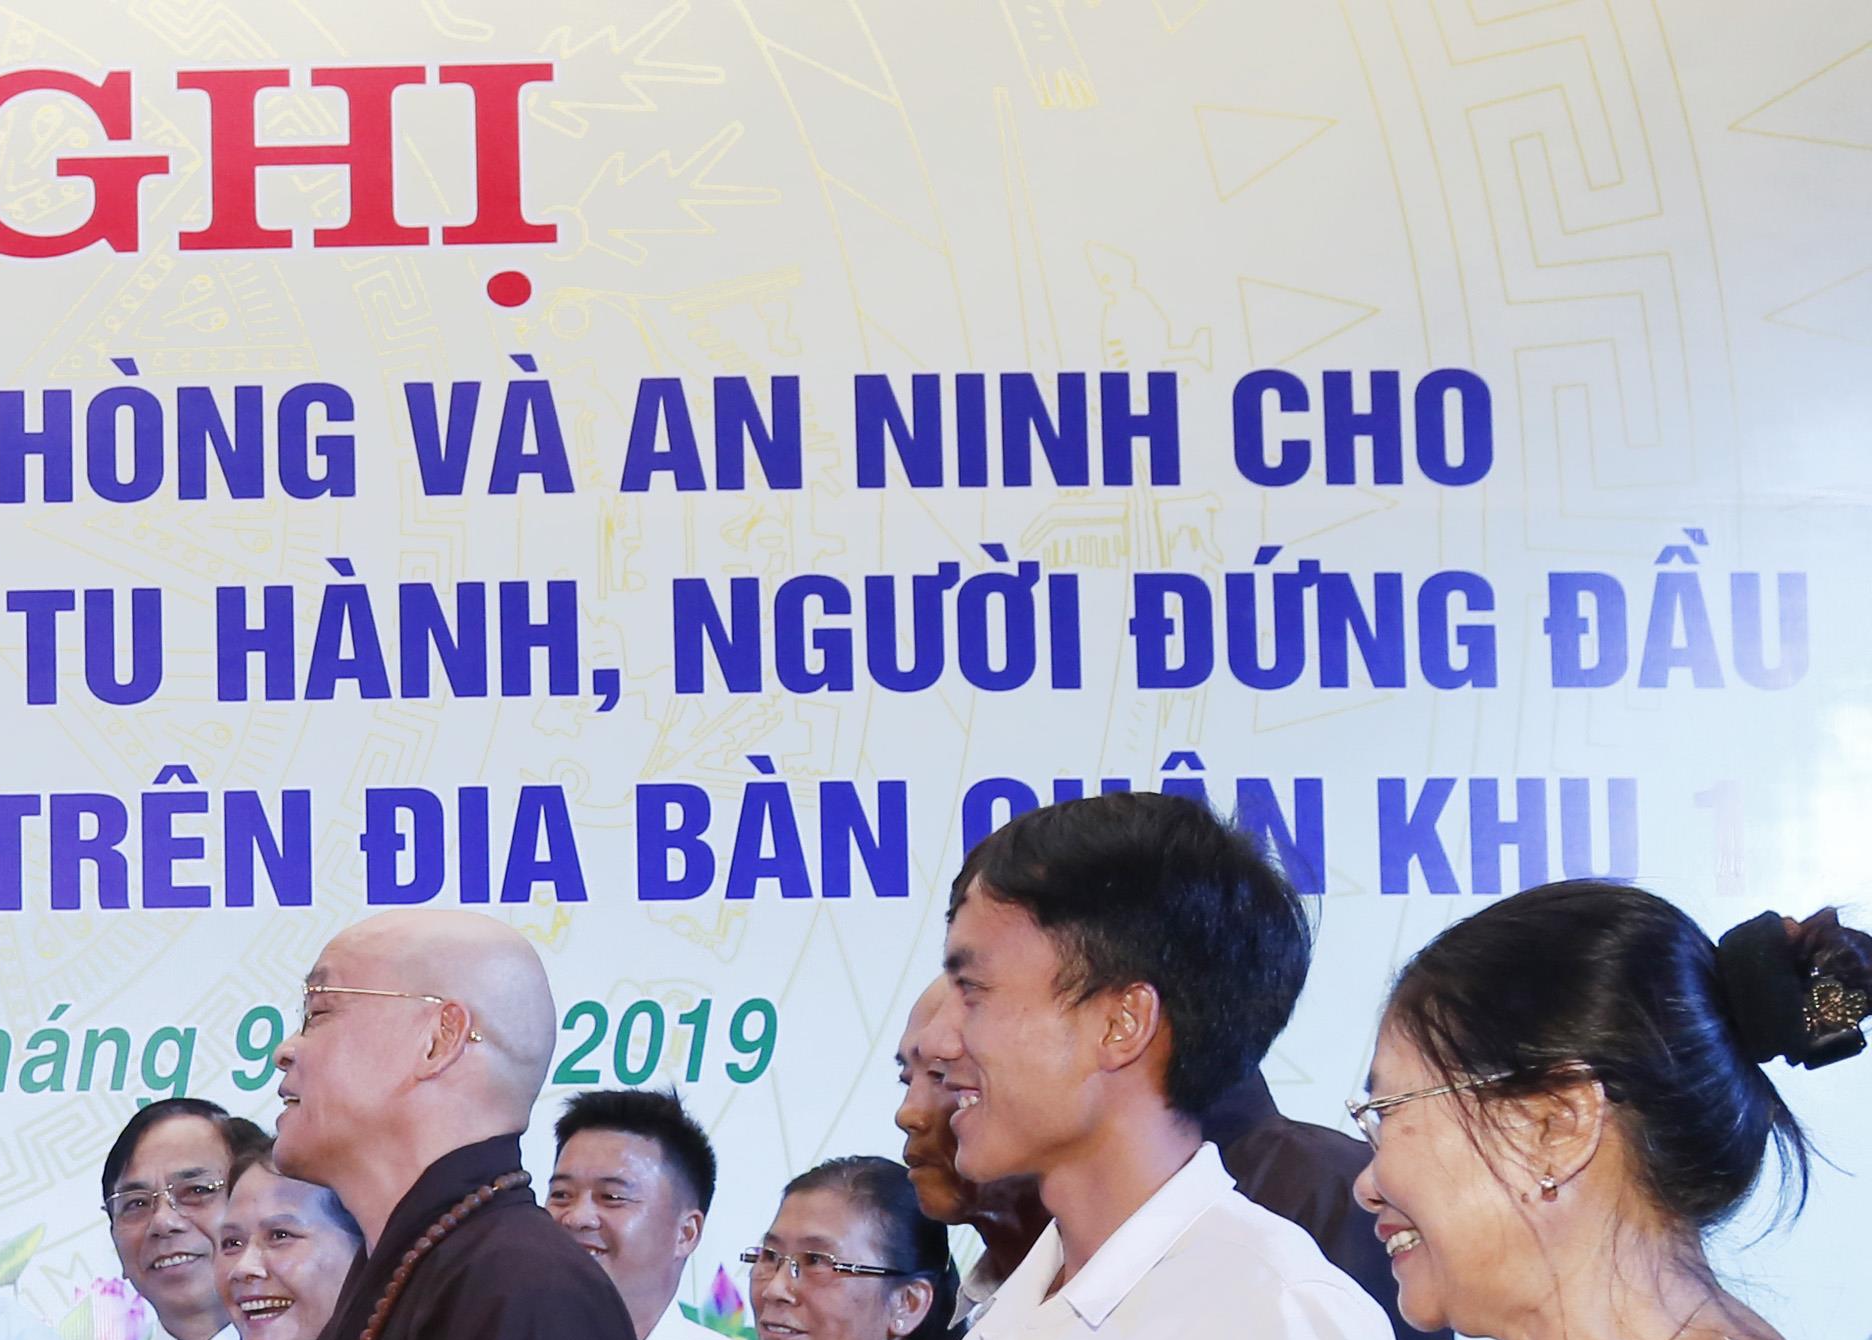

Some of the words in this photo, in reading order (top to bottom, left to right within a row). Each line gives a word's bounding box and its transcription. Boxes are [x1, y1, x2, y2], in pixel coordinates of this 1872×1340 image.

[404, 354, 575, 497] VÀ
[620, 375, 803, 493] AN
[855, 371, 1181, 490] NINH
[1232, 368, 1494, 488] CHO
[6, 587, 164, 706] TU
[216, 557, 621, 713] HÀNH,
[672, 543, 1082, 696] NGƯỜI
[1128, 545, 1498, 692] ĐỨNG
[1543, 527, 1810, 691] ĐẦU
[635, 754, 910, 902] BÀN
[1377, 776, 1639, 897] KHU
[551, 998, 779, 1086] 2019
